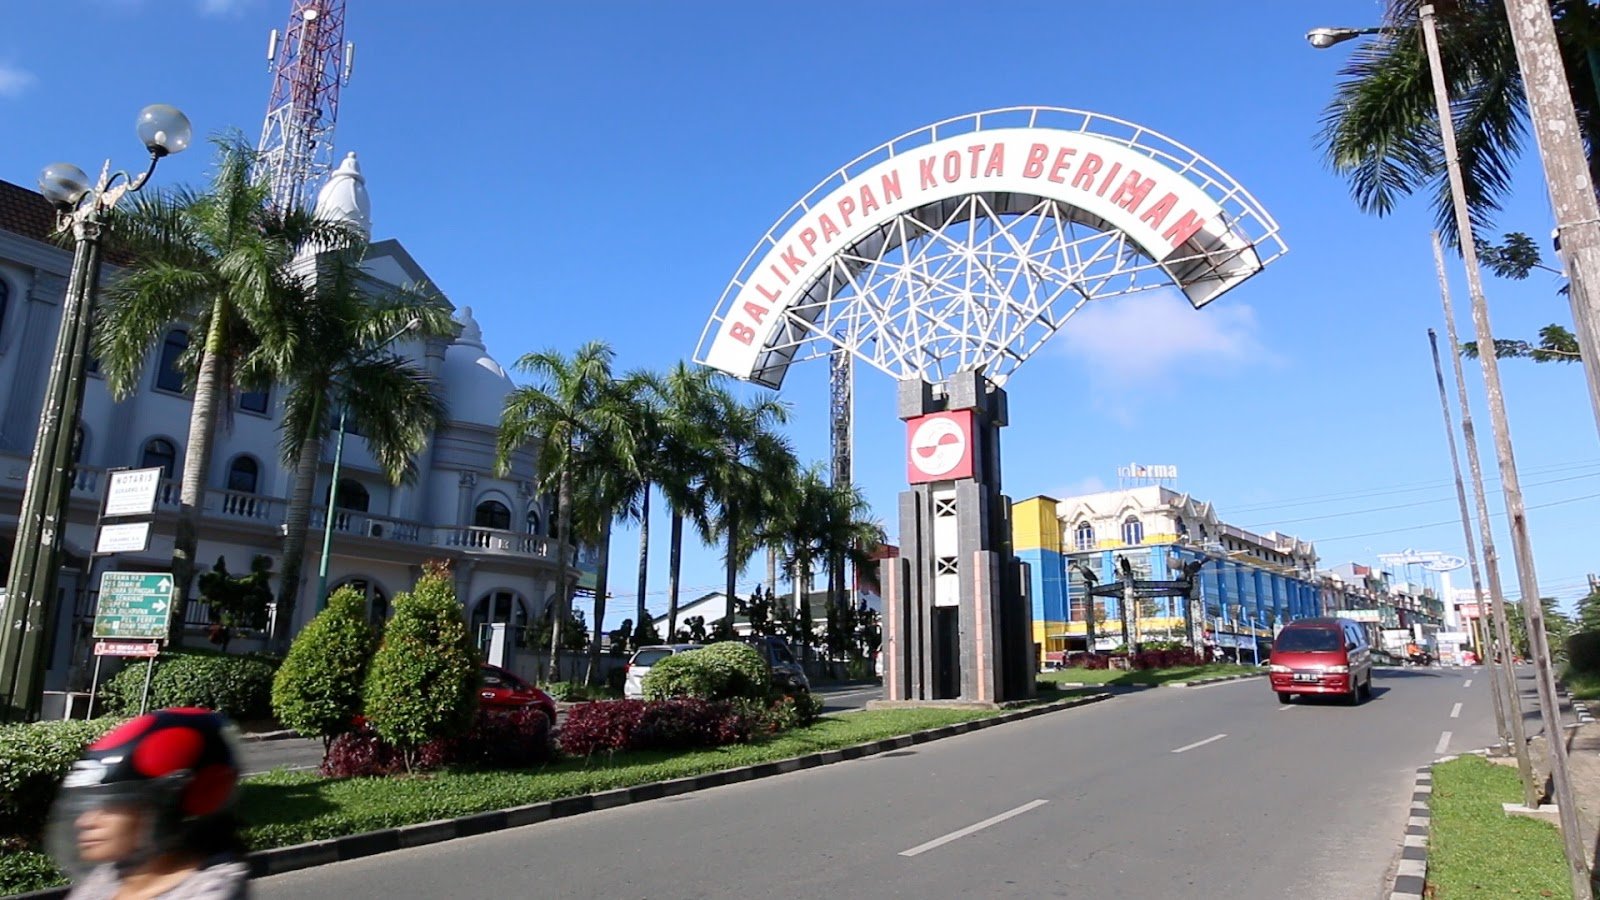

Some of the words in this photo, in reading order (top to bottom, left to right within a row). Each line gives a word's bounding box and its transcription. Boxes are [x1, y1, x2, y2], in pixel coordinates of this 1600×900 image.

[729, 169, 902, 346] BALIKPAPAN
[919, 143, 1005, 191] KOTA
[1022, 143, 1206, 249] BERIMAN
[117, 473, 153, 484] NOTARIS
